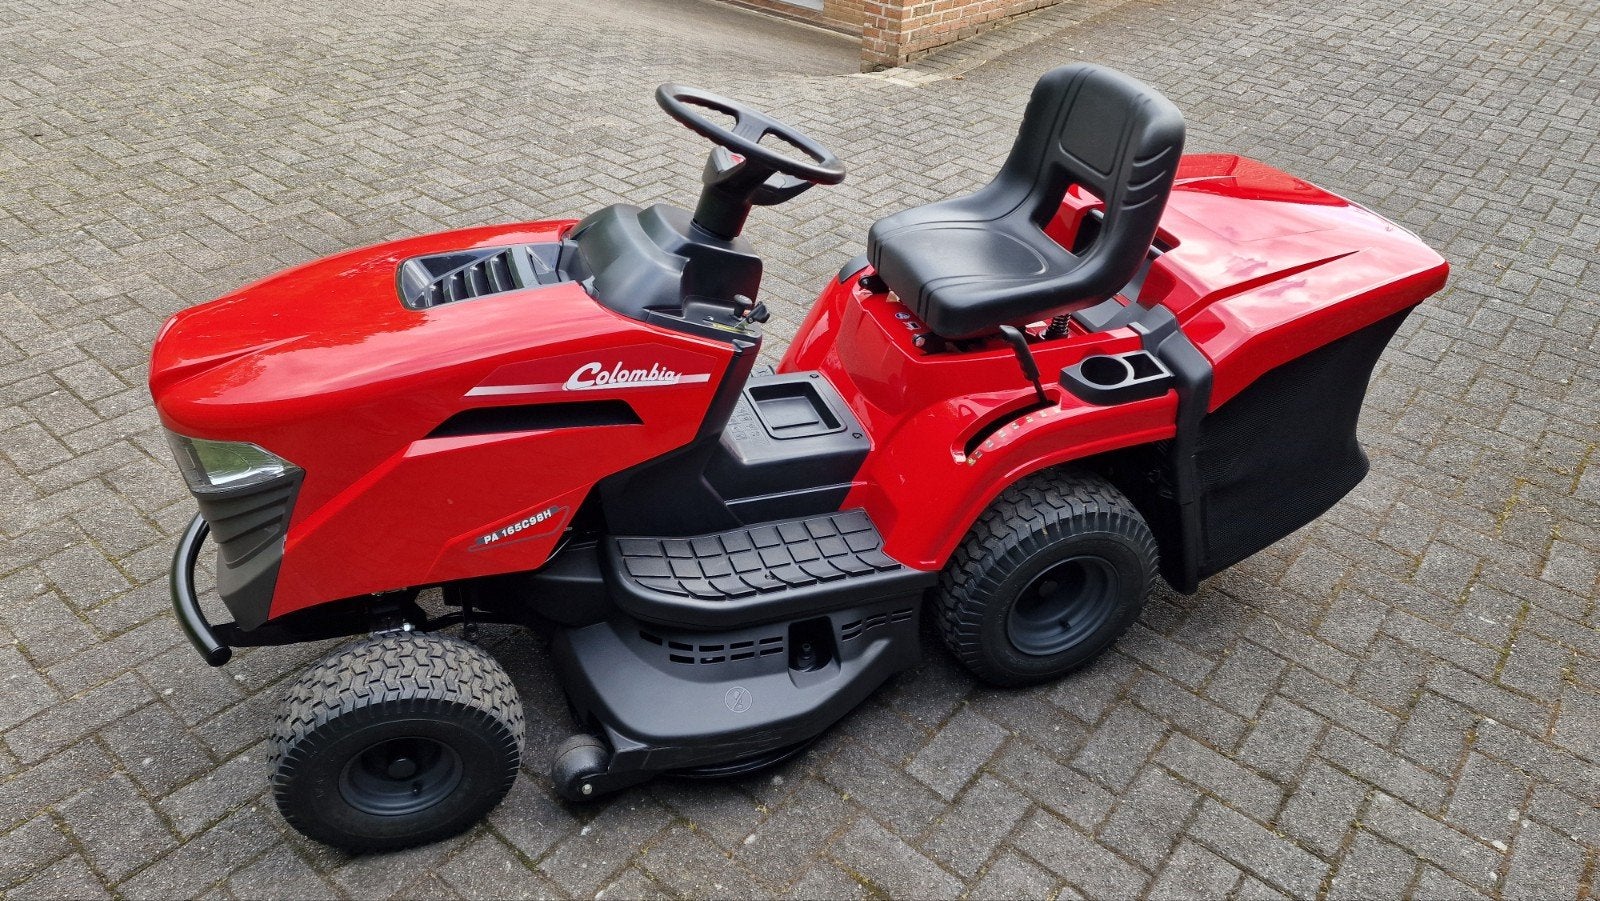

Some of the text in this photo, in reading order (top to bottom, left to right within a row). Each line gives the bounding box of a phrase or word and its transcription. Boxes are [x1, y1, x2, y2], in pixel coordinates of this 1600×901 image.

[563, 361, 682, 391] Colombia
[484, 509, 552, 545] PA 165C98H
